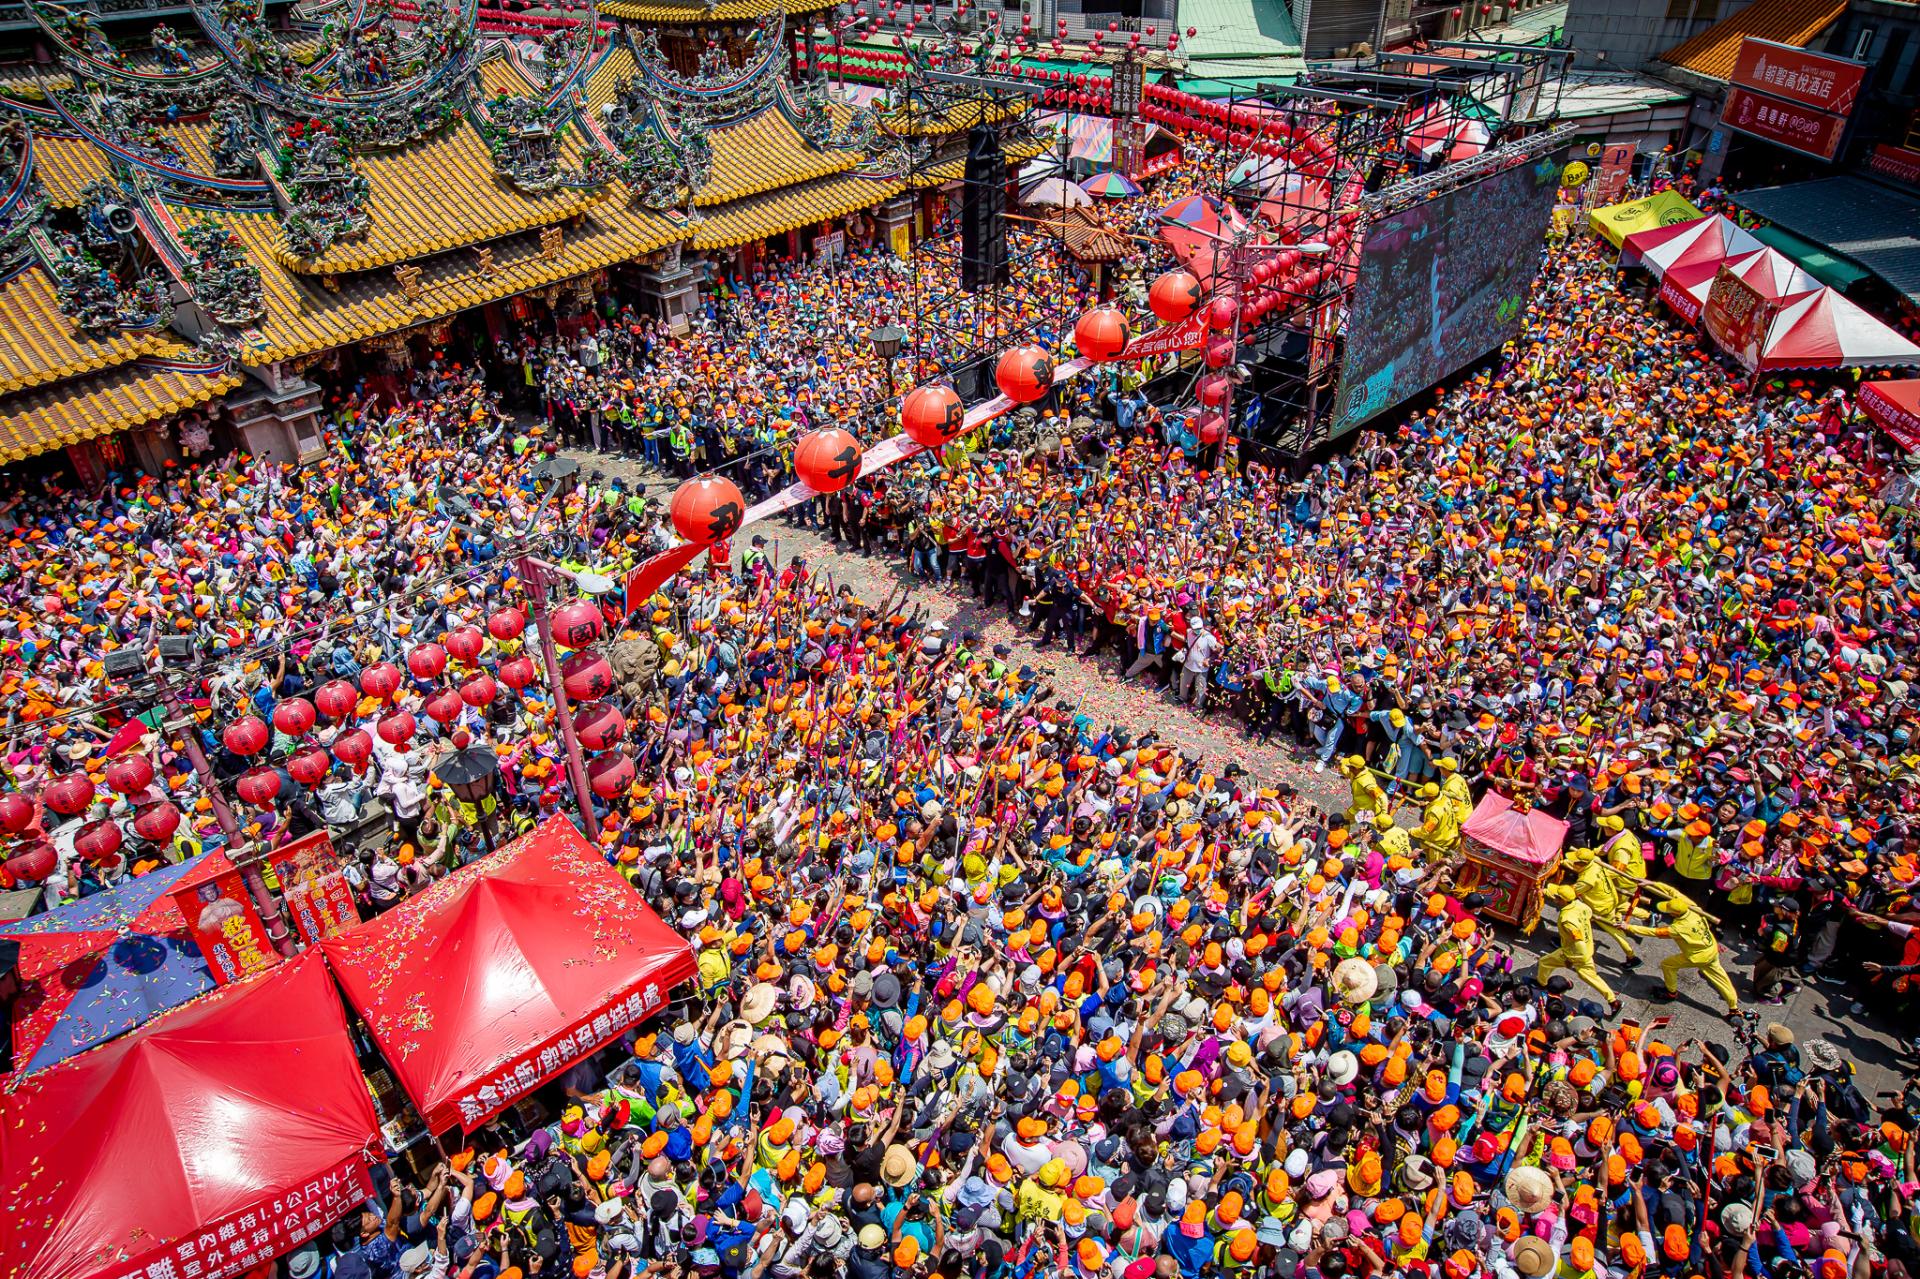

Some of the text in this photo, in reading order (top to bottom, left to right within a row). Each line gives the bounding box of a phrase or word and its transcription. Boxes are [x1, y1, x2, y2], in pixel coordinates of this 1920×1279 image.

[1614, 149, 1628, 165] P
[1566, 171, 1584, 183] Bar
[828, 446, 860, 479] 千
